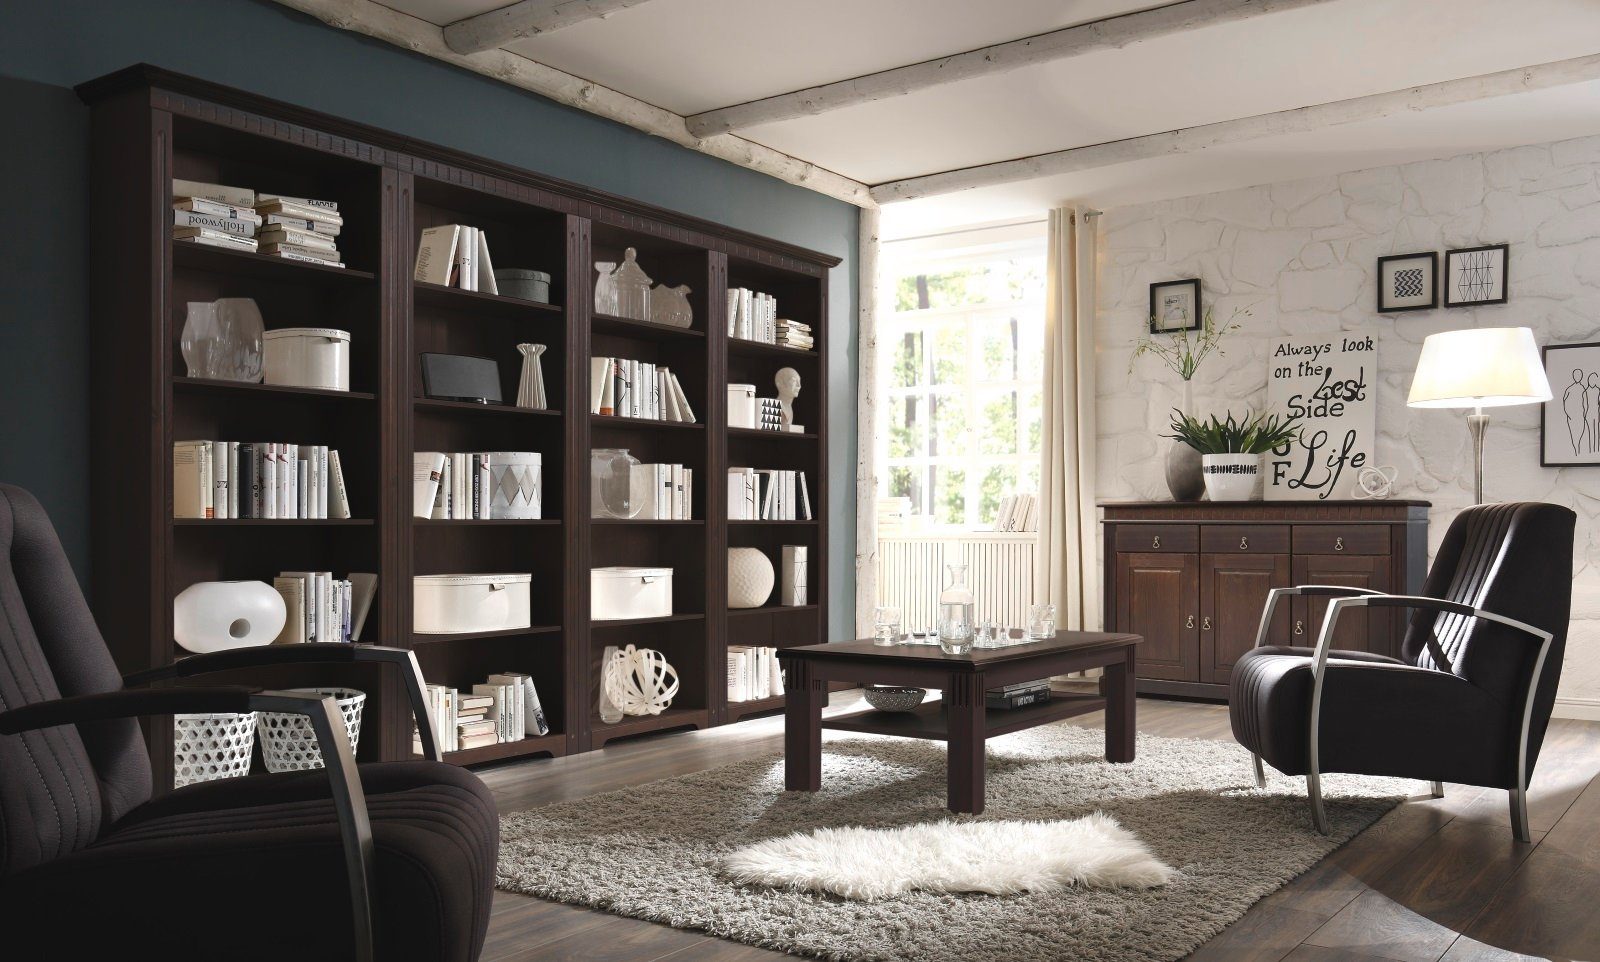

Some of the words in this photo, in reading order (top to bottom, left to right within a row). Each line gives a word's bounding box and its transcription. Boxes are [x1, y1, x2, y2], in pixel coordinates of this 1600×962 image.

[188, 216, 245, 233] Hollywood
[1274, 343, 1331, 361] Always
[1341, 336, 1374, 352] look
[1274, 366, 1292, 379] on
[1298, 360, 1324, 377] the
[1312, 366, 1367, 402] best
[1286, 394, 1345, 419] Side
[1287, 429, 1366, 500] Life
